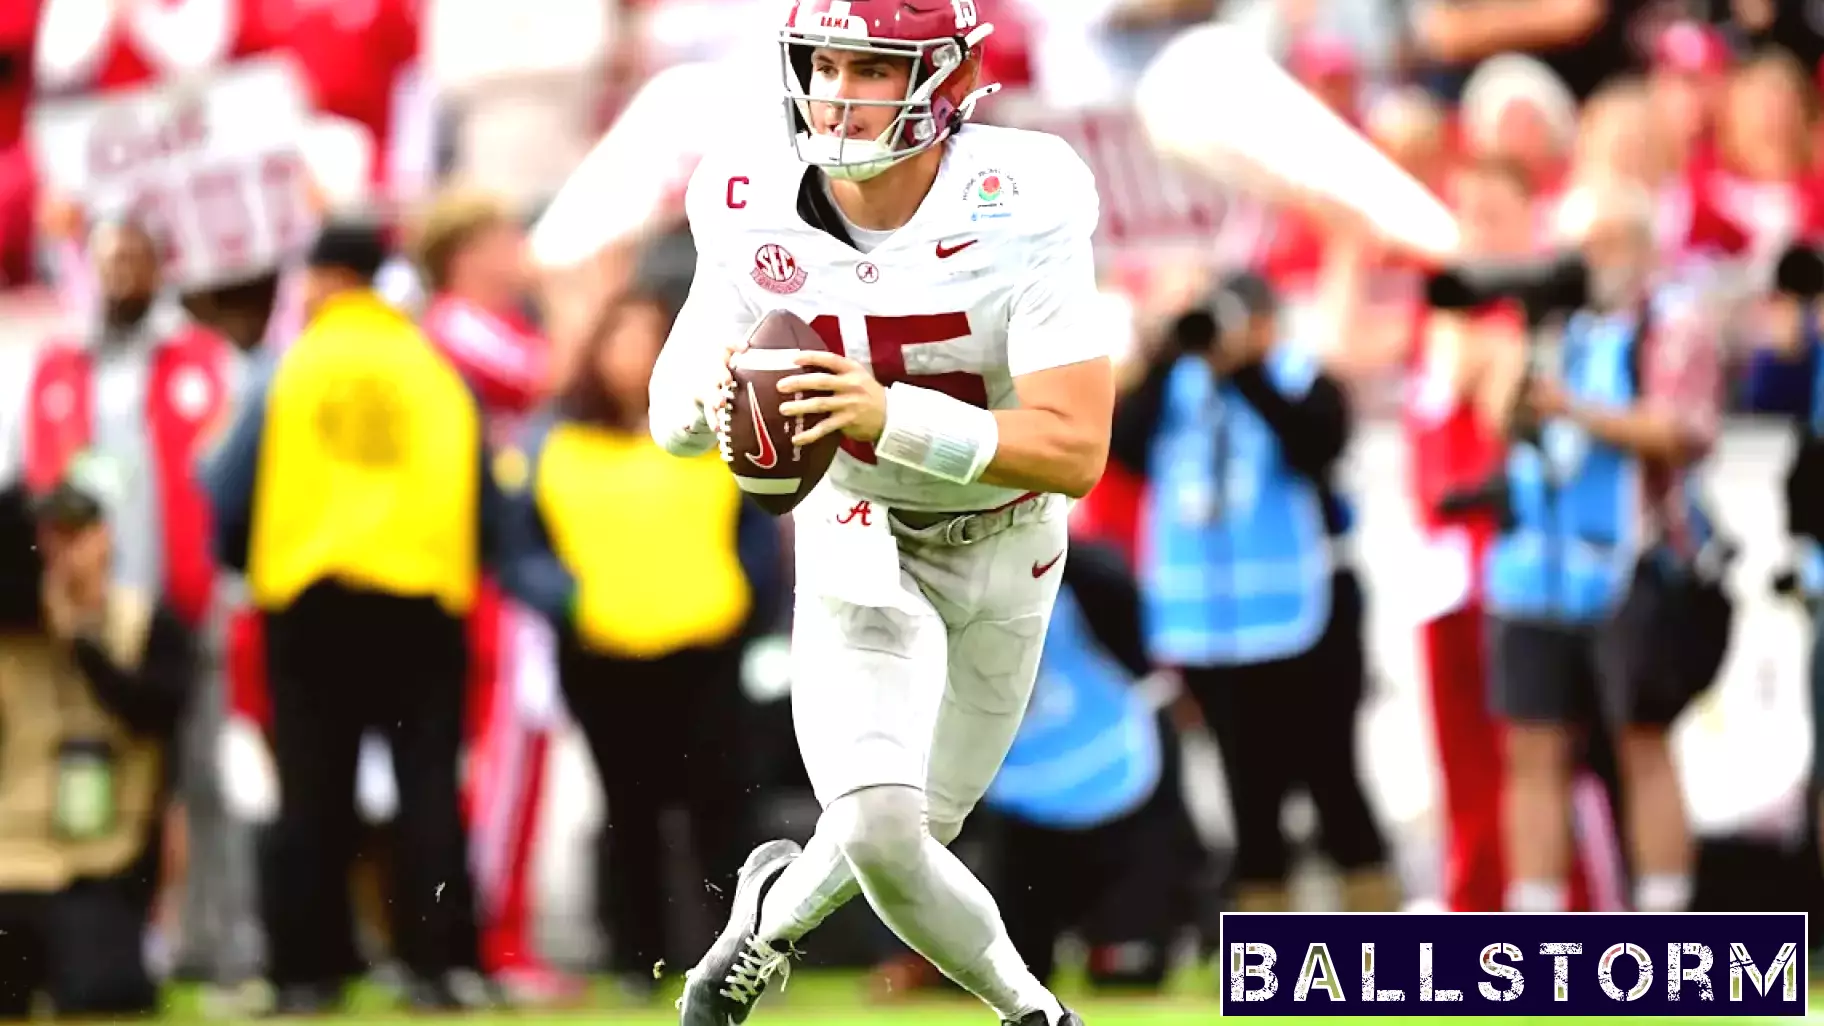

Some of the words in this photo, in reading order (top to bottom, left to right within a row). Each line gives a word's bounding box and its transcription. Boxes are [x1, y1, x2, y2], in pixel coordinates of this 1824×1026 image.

[726, 175, 750, 209] C
[757, 246, 794, 281] SEC
[836, 500, 872, 526] A
